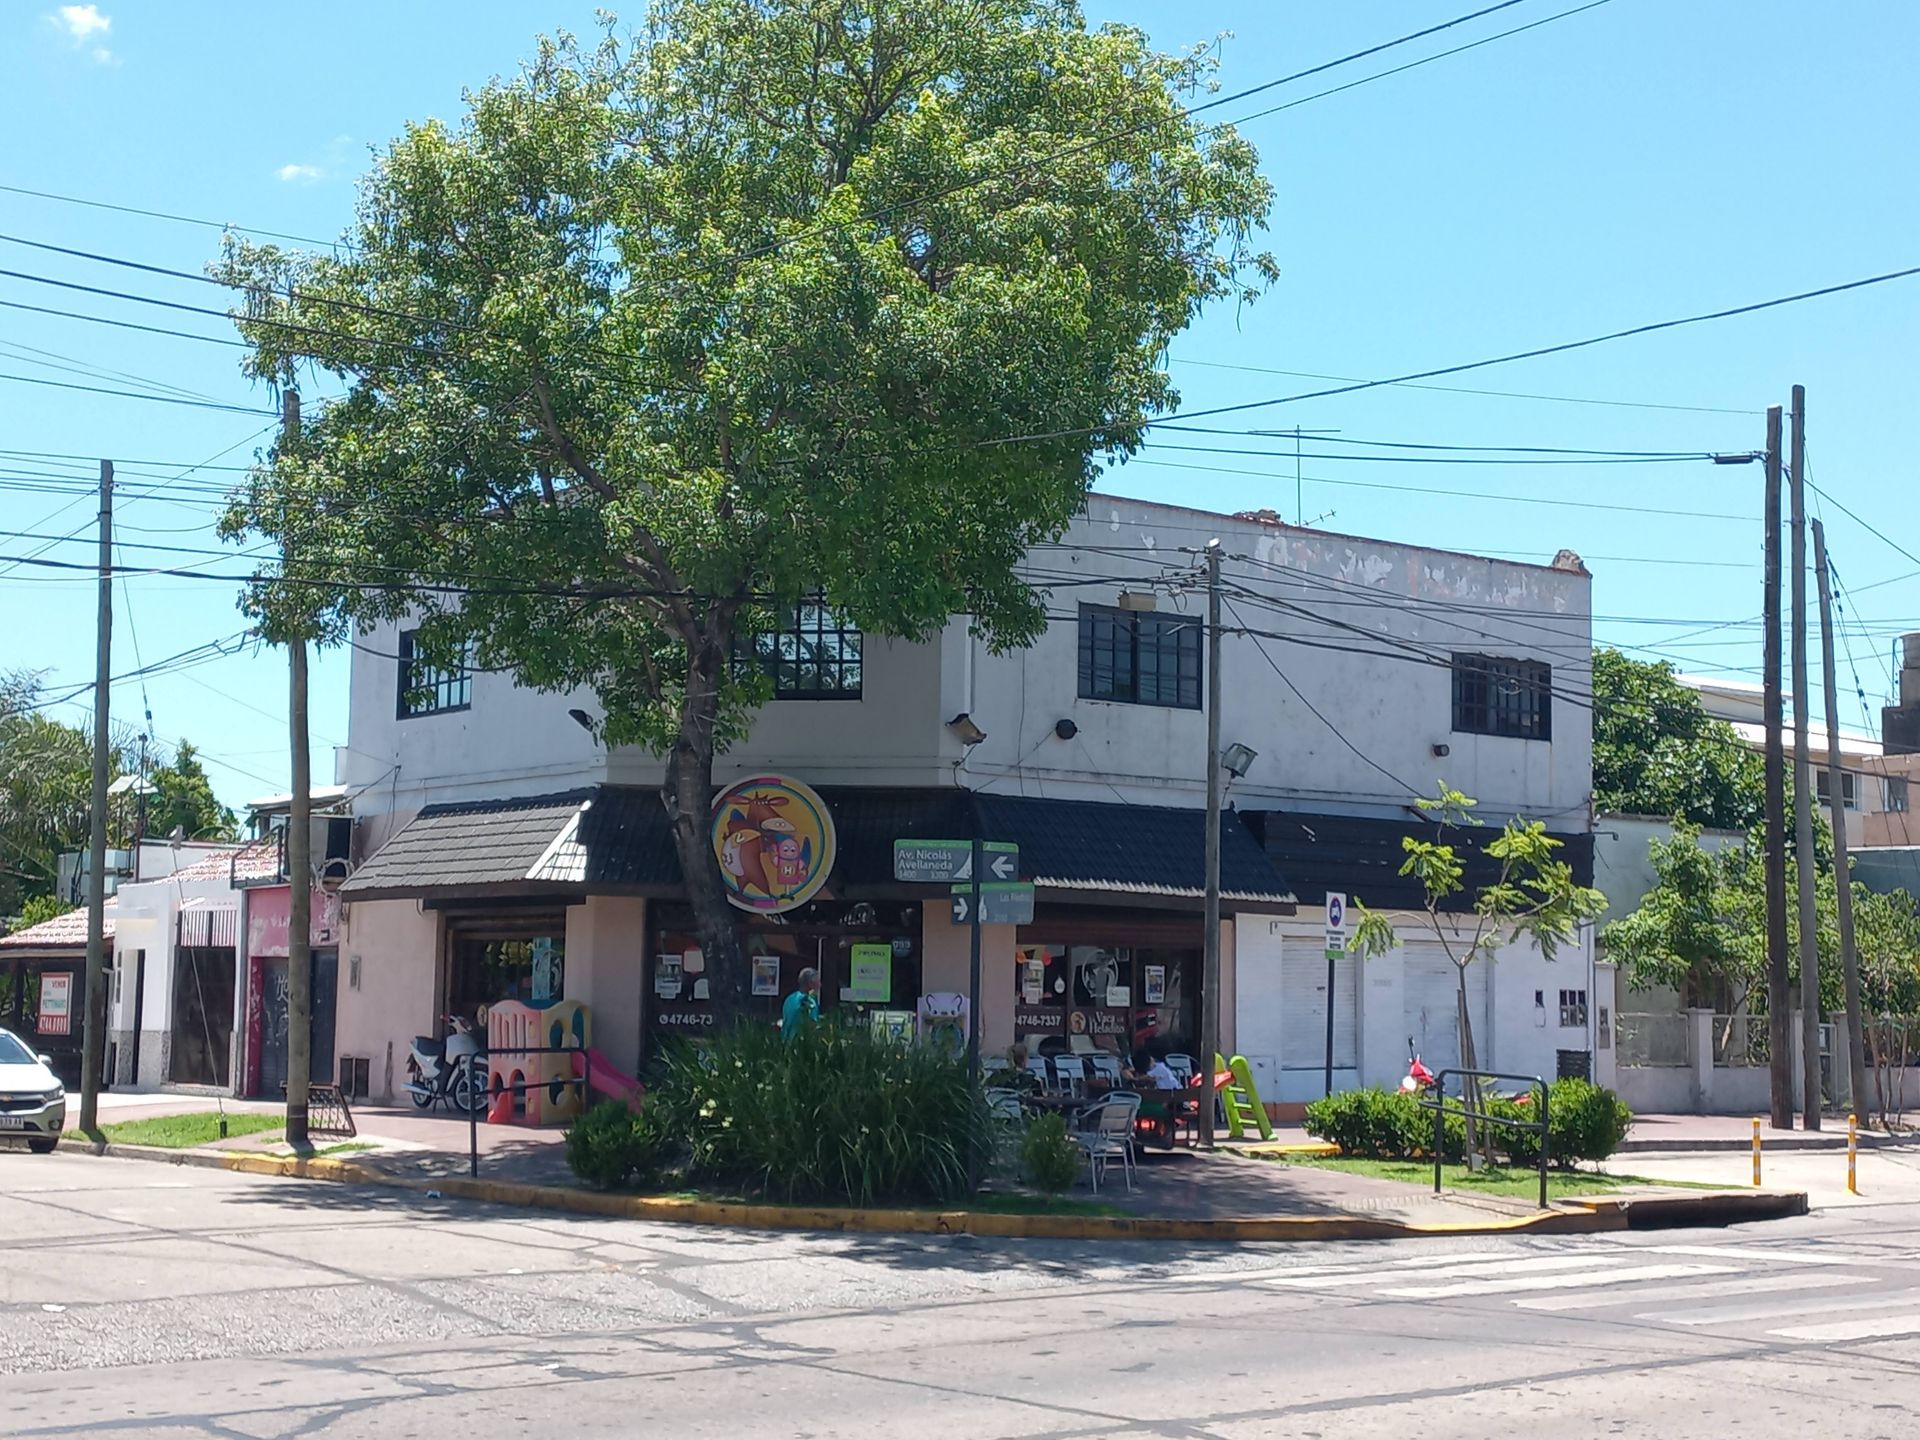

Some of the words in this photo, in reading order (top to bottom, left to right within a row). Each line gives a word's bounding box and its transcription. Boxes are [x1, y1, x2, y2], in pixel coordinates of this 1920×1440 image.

[898, 849, 914, 860] Av.
[916, 849, 952, 861] Nicolás
[898, 859, 953, 871] Avellaneda
[669, 1014, 713, 1025] 4746-73
[1016, 1015, 1061, 1026] 4746-7337
